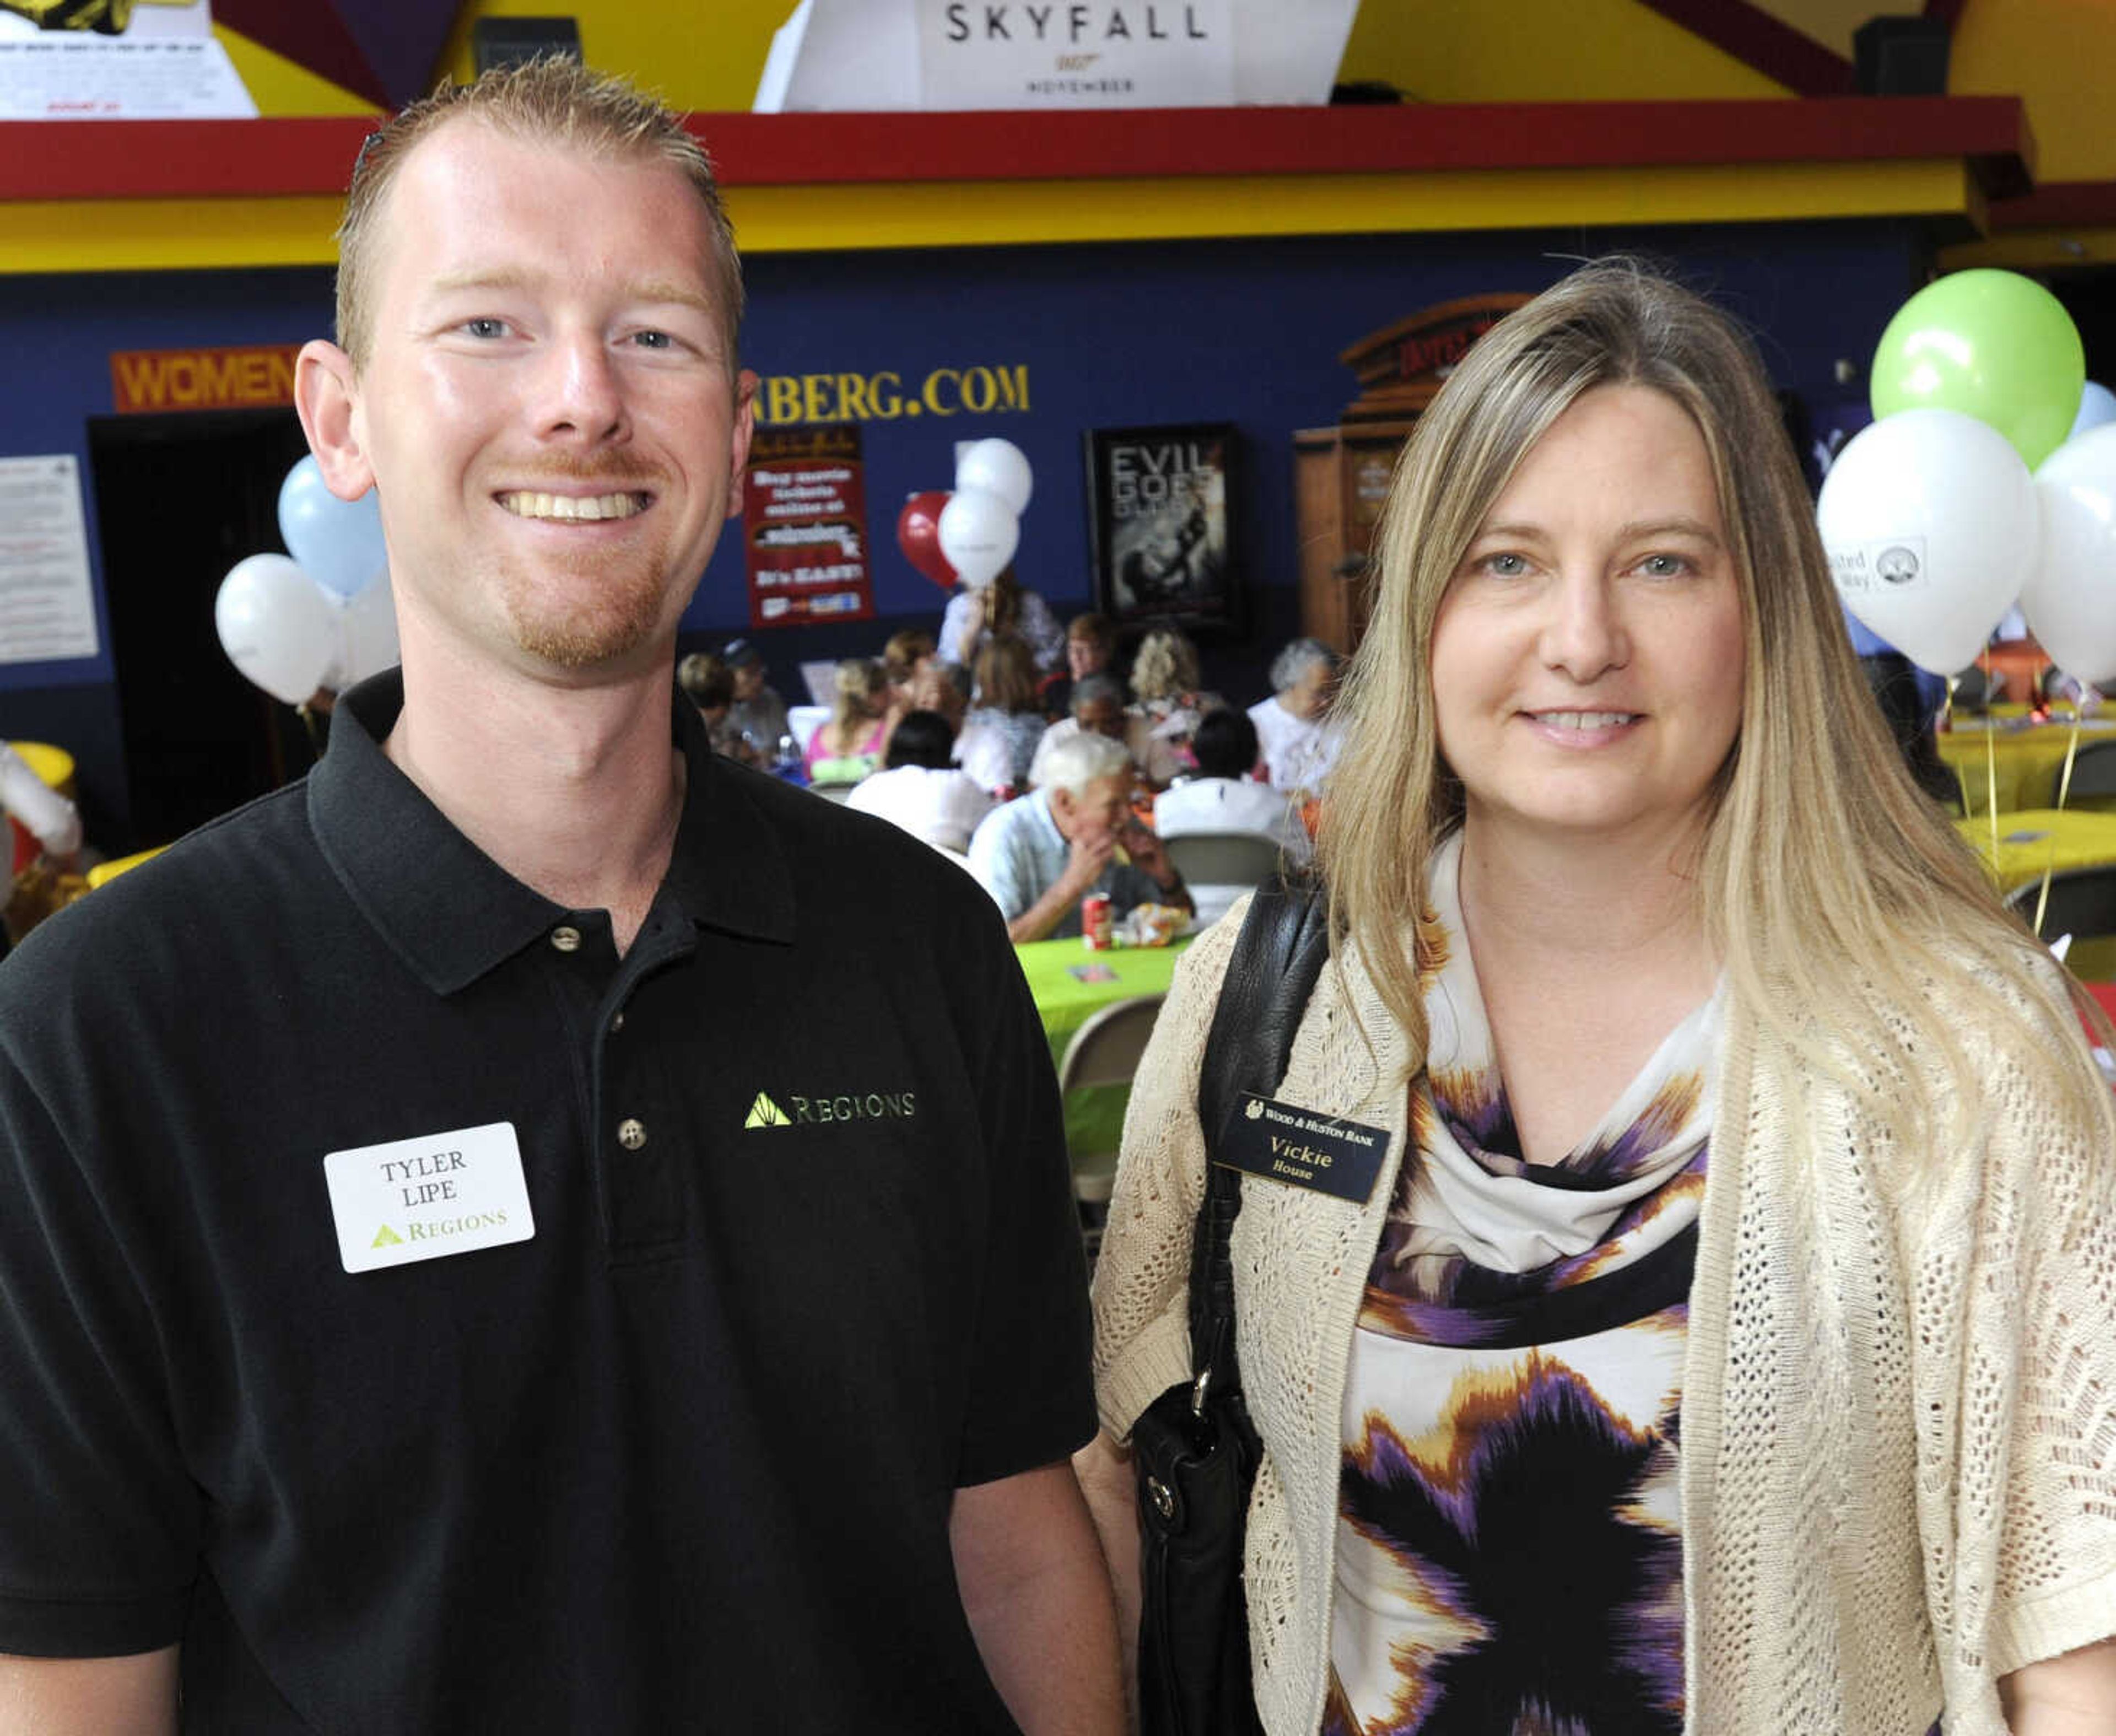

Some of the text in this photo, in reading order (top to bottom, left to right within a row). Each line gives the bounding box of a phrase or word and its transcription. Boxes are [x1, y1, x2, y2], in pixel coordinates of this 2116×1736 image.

[946, 3, 1207, 42] SKYFALL
[1027, 79, 1135, 93] NOVEMBER
[118, 353, 296, 406] WOMEN
[1111, 443, 1214, 476] EVIL
[791, 1093, 915, 1123] REGIONS
[1294, 1118, 1305, 1128] &
[381, 1150, 467, 1182] TYLER
[1271, 1135, 1334, 1167] Vickie
[1273, 1159, 1315, 1180] House
[402, 1180, 457, 1207] LIPE
[408, 1209, 508, 1242] REGIONS
